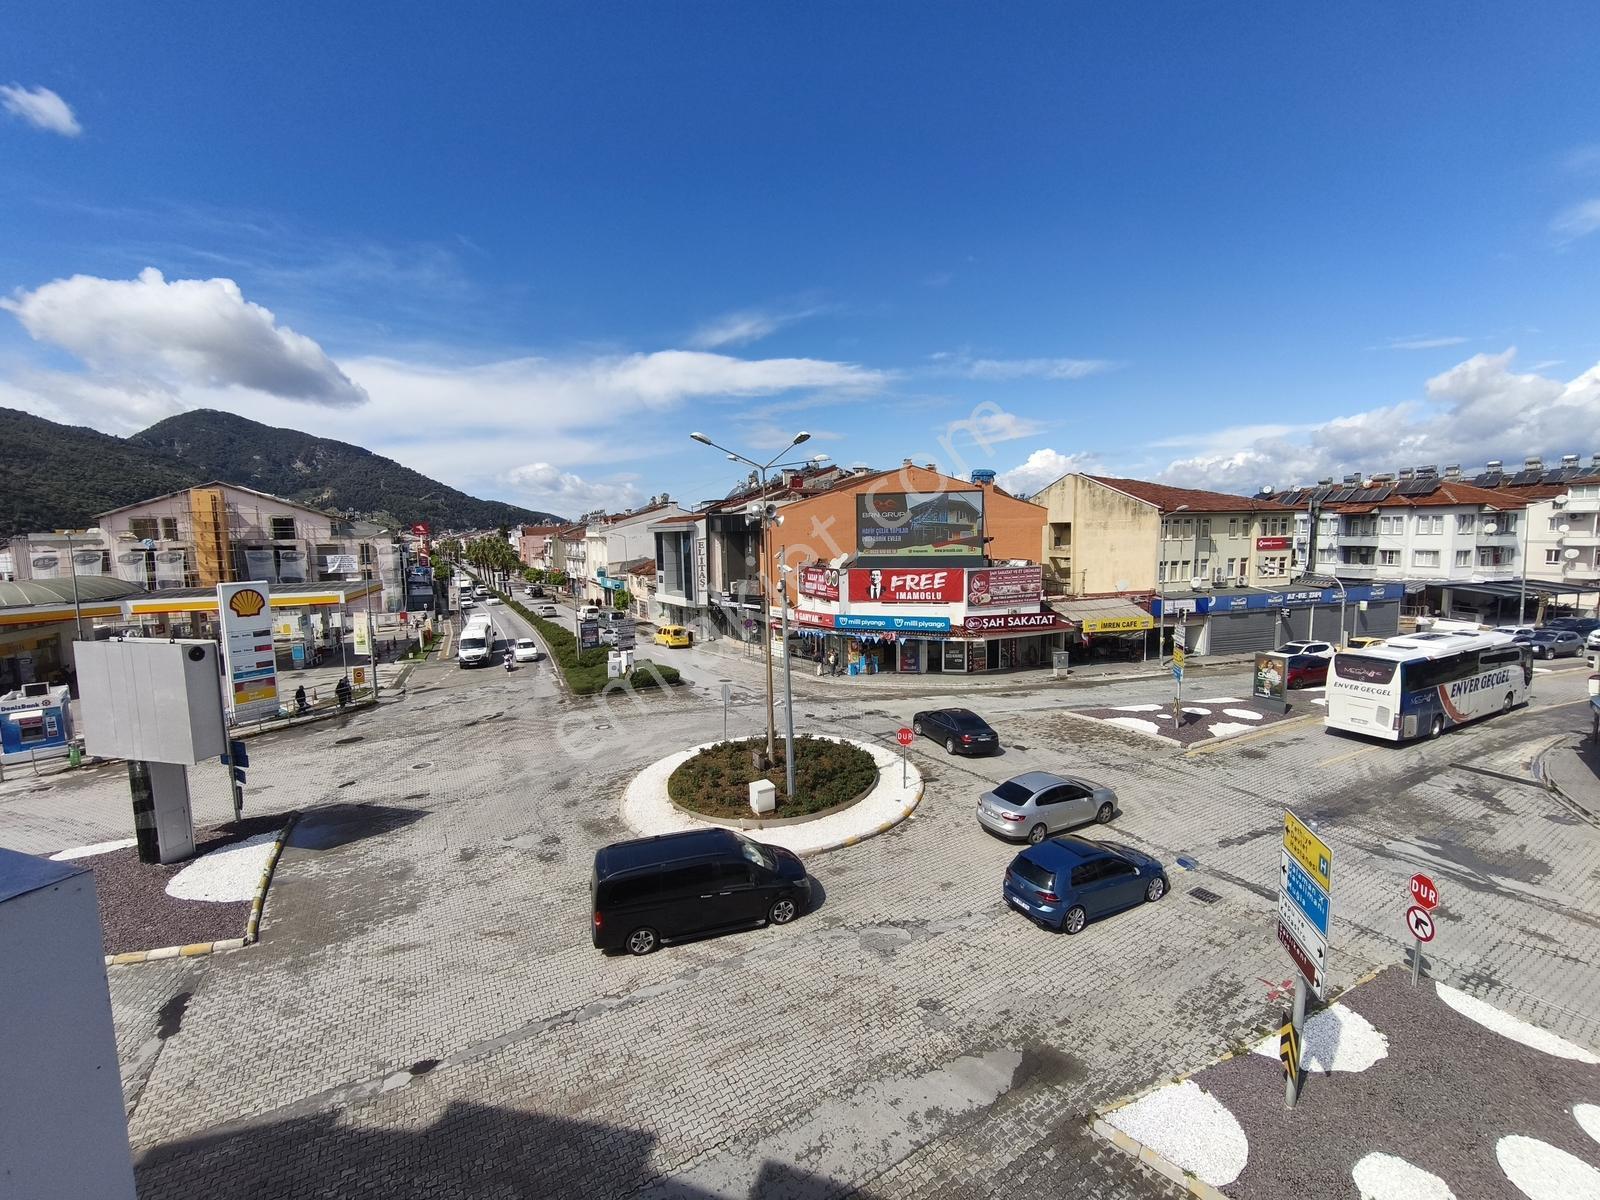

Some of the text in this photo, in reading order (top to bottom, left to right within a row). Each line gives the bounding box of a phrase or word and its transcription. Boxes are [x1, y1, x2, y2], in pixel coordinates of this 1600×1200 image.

[890, 571, 948, 592] FREE
[896, 591, 942, 600] IMAMOGLU
[861, 618, 886, 627] piyango
[918, 620, 946, 628] piyango
[982, 615, 1055, 629] ŞAH SAKATAT
[1121, 620, 1138, 628] CAFE
[1333, 681, 1392, 697] ENVER GEÇGEL
[1451, 669, 1510, 698] ENVER GEÇGEL
[1, 702, 40, 712] DenizBank
[897, 732, 913, 740] DUR
[1290, 830, 1308, 853] Devlet
[1290, 840, 1318, 873] Hastanesi
[1288, 860, 1316, 896] Dalaman
[1411, 880, 1436, 904] DUR
[1280, 906, 1306, 942] Kadastro
